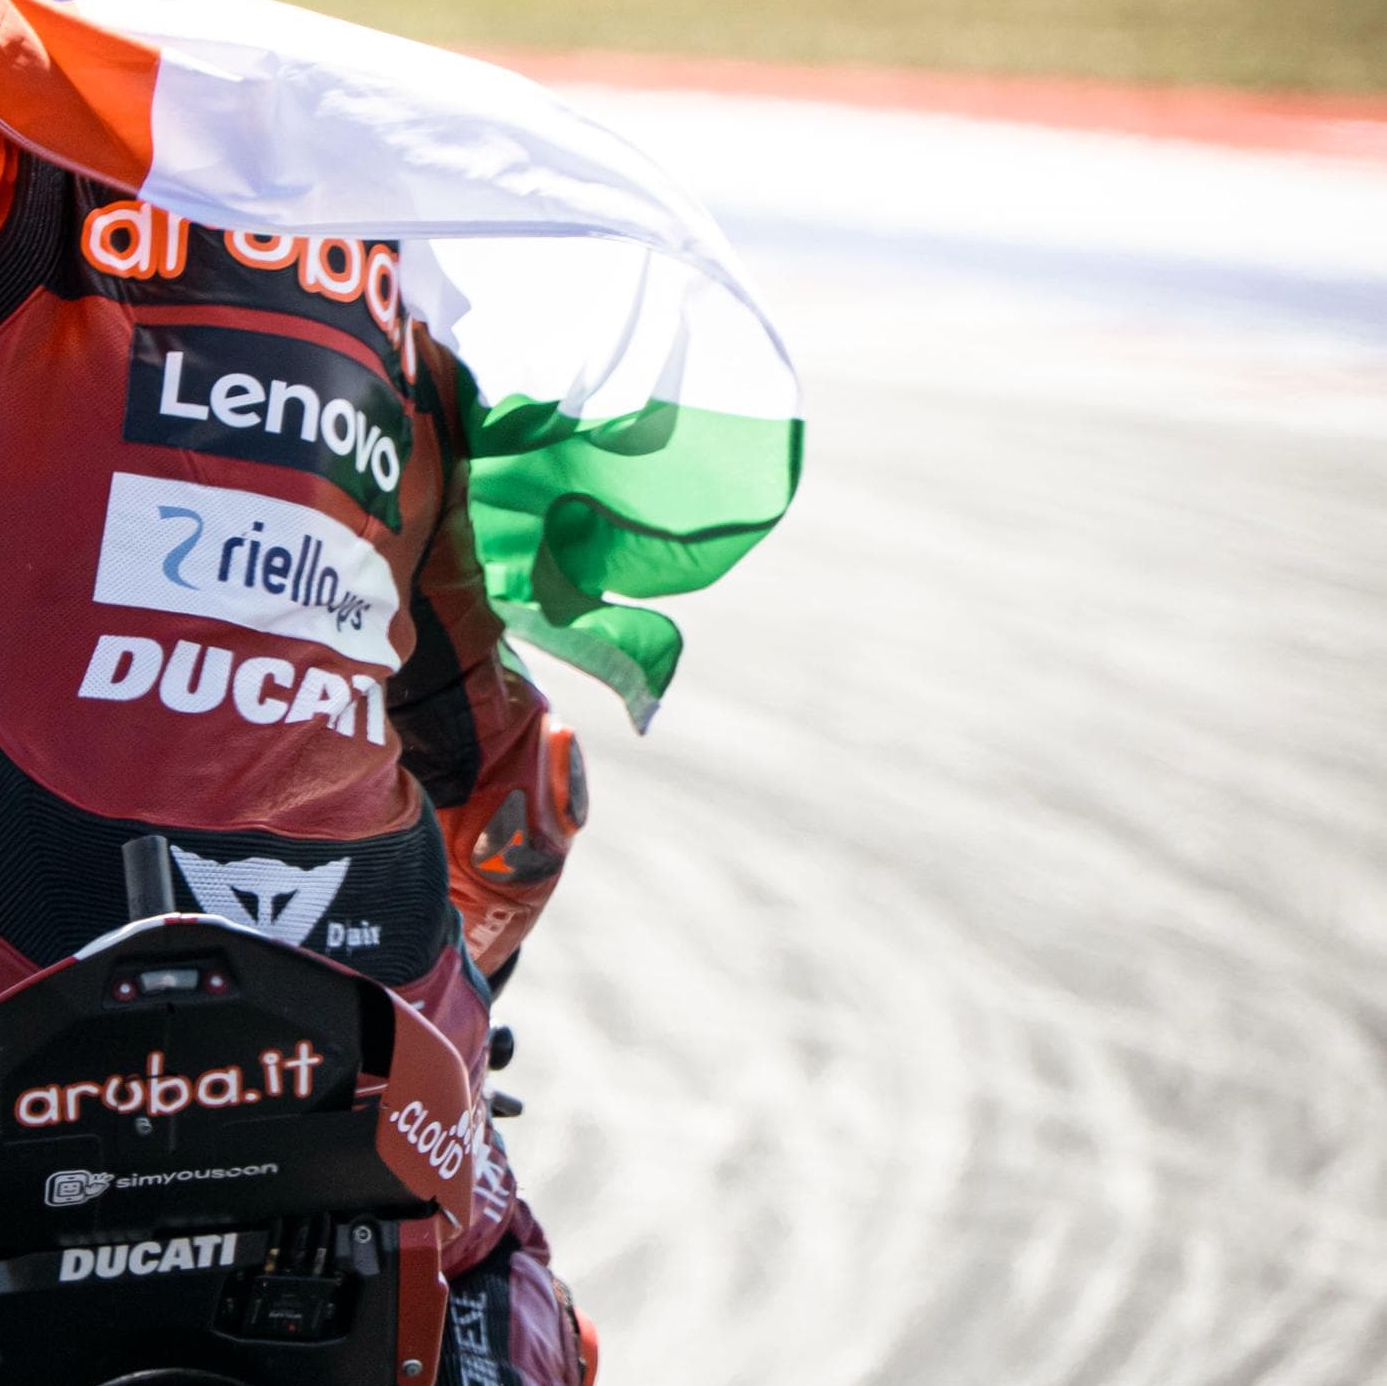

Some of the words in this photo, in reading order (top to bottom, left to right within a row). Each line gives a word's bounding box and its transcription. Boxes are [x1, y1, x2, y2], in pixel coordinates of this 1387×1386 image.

[159, 351, 400, 493] Lenovo
[15, 1039, 324, 1128] aruba.it
[115, 1163, 279, 1191] simyousoon
[59, 1233, 238, 1282] DUCATI
